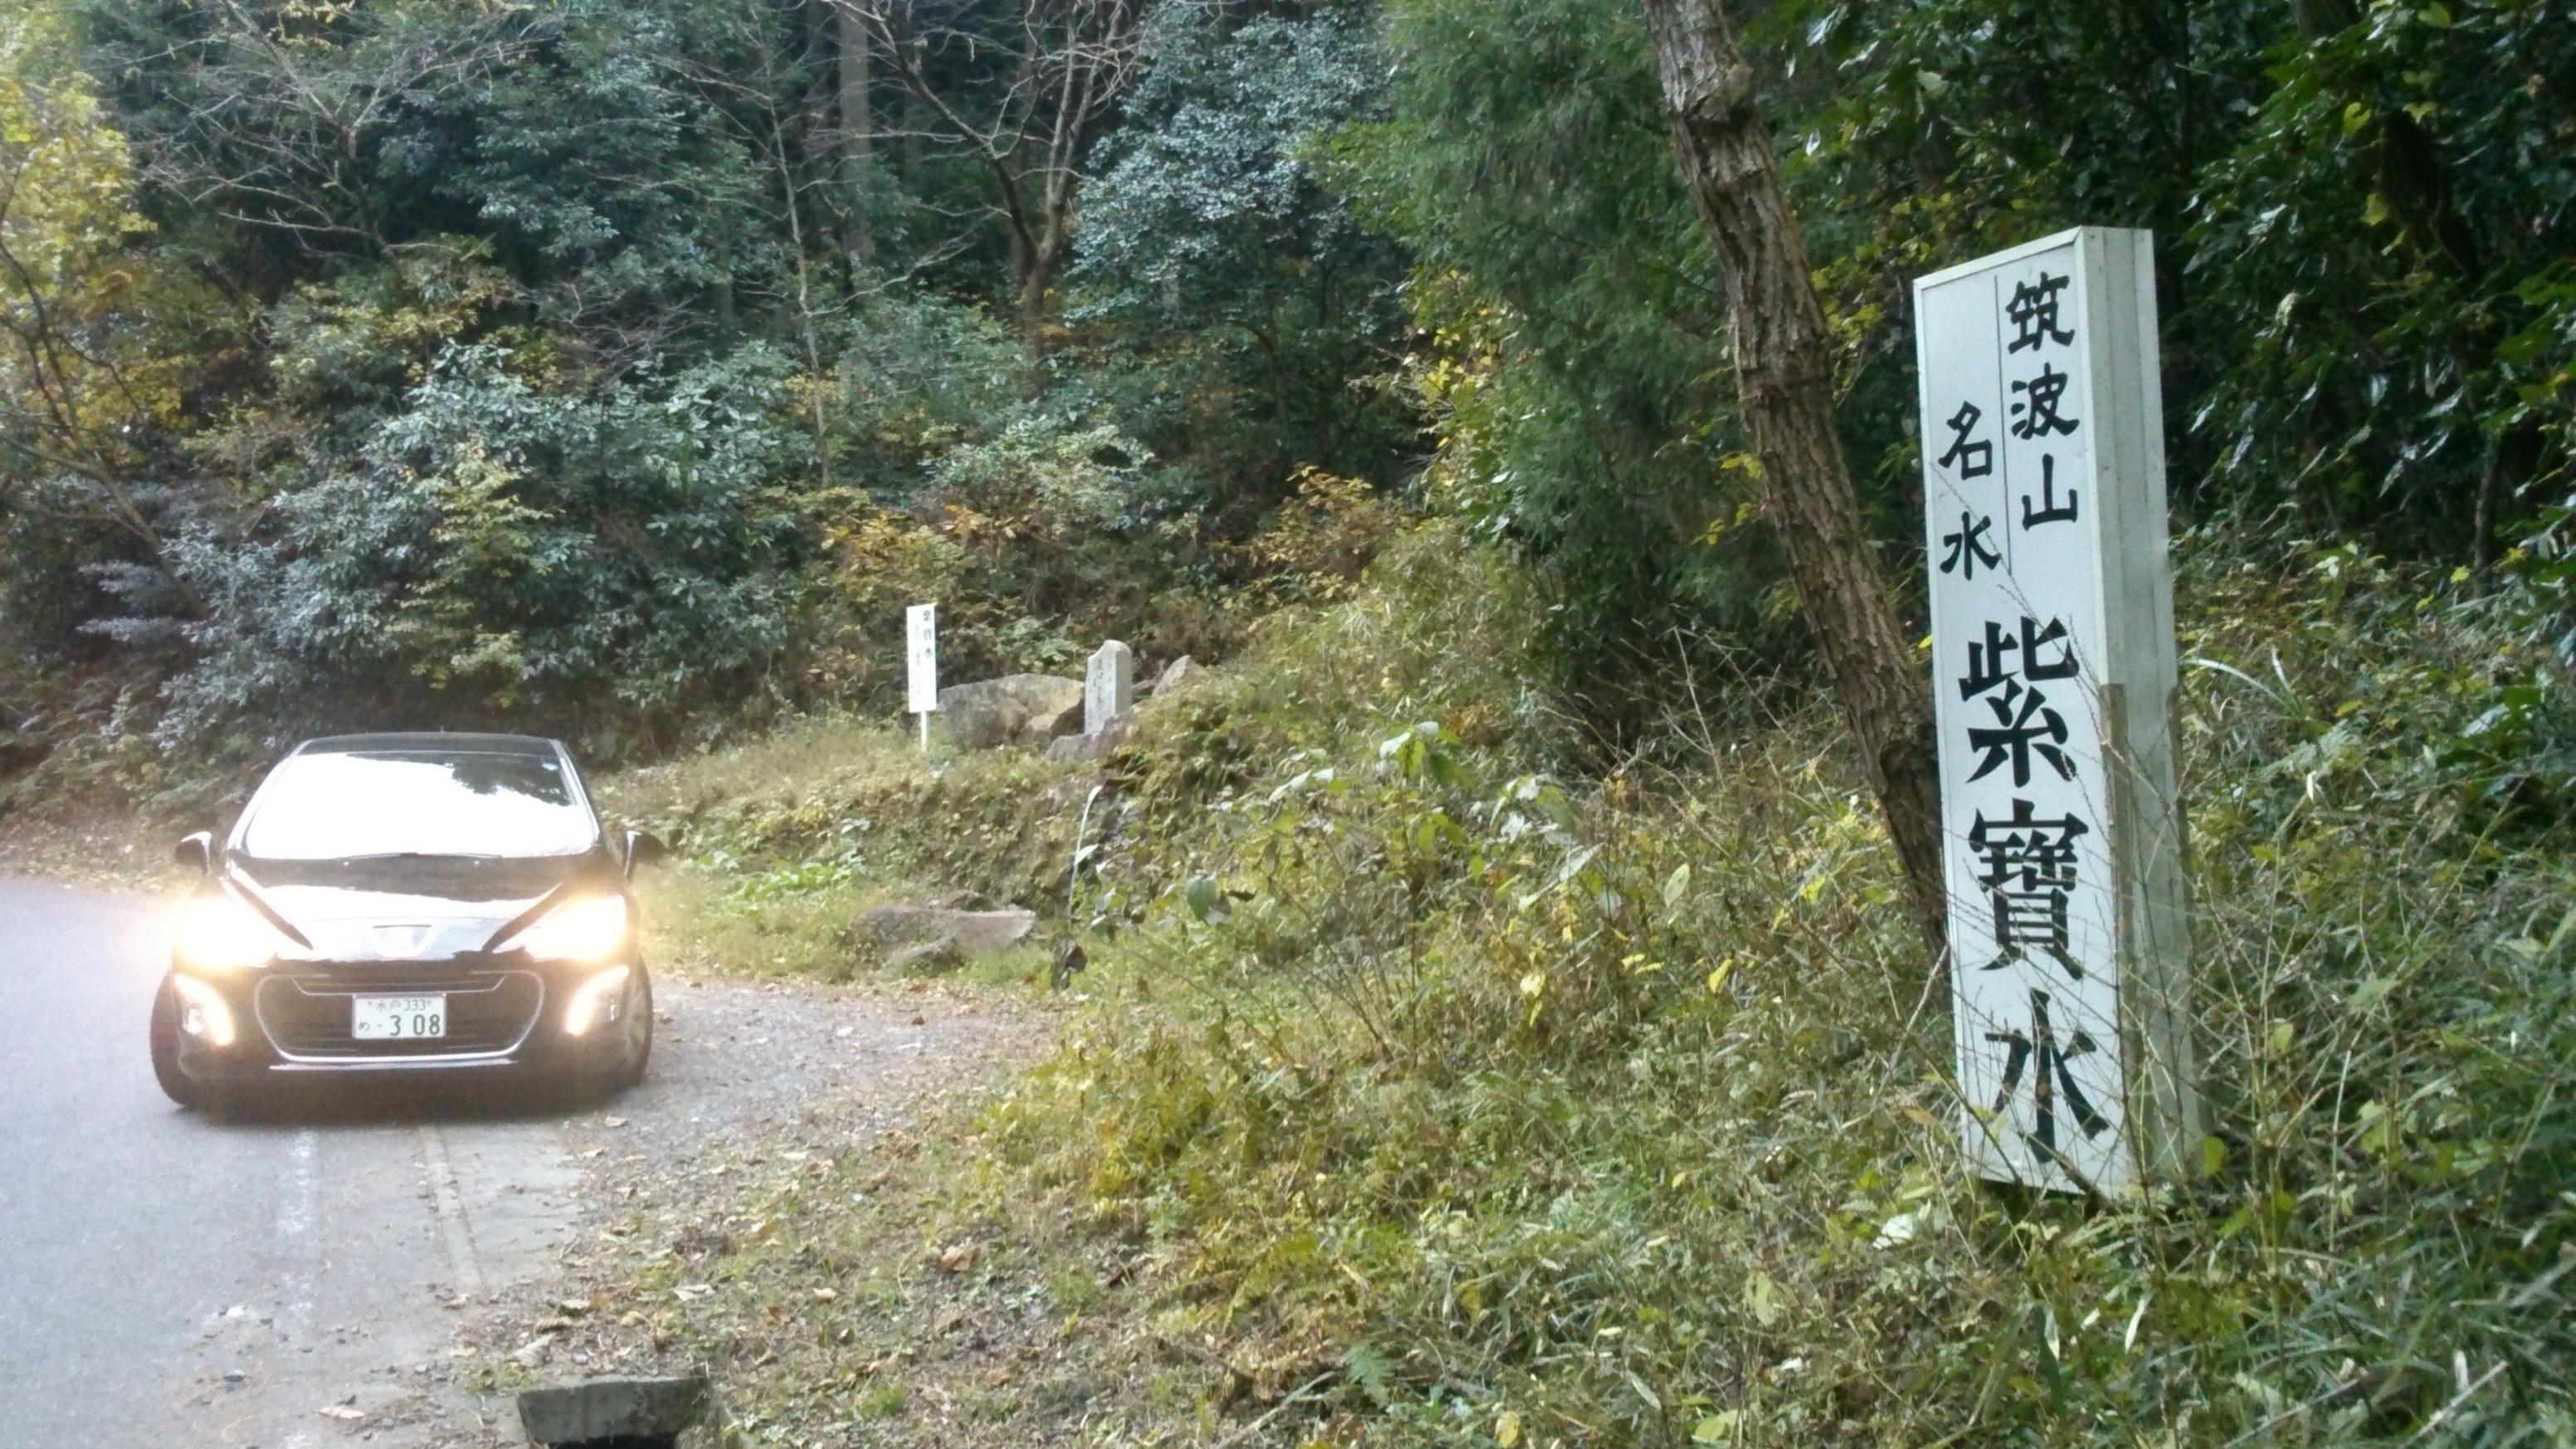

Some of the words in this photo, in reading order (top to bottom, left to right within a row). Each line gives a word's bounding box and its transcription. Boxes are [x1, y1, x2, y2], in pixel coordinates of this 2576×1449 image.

[2006, 271, 2079, 530] 筑波山
[1938, 401, 2002, 580] 名水
[403, 999, 426, 1011] 333
